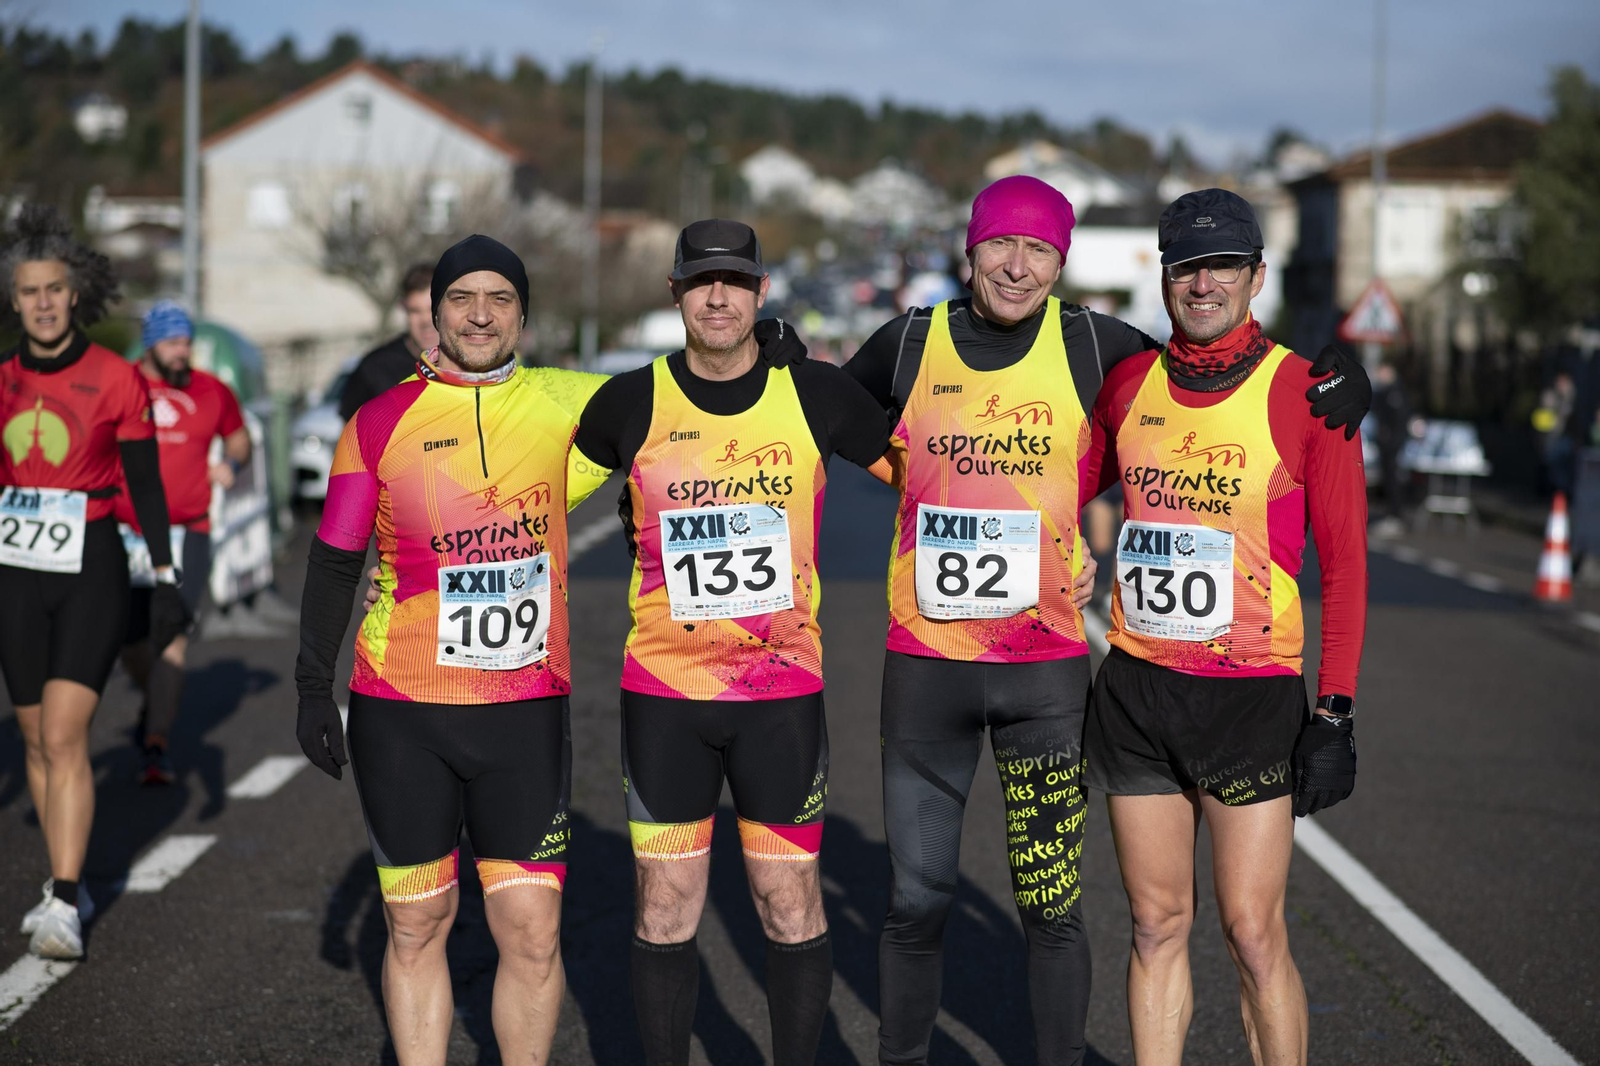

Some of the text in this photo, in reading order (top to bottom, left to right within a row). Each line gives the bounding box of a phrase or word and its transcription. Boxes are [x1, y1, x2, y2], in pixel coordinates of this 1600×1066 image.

[1317, 375, 1346, 394] Kaytan
[927, 428, 1051, 461] esprintes
[667, 470, 793, 506] esprintes
[1124, 466, 1242, 497] esprintes
[1, 517, 72, 553] 279
[430, 512, 549, 557] esprintes
[667, 513, 727, 542] XXII
[922, 511, 978, 540] XXII
[1122, 528, 1171, 557] XXII
[445, 570, 506, 594] XXII
[673, 546, 777, 597] 133
[936, 551, 1009, 599] 82
[1124, 566, 1217, 618] 130
[448, 598, 539, 649] 109
